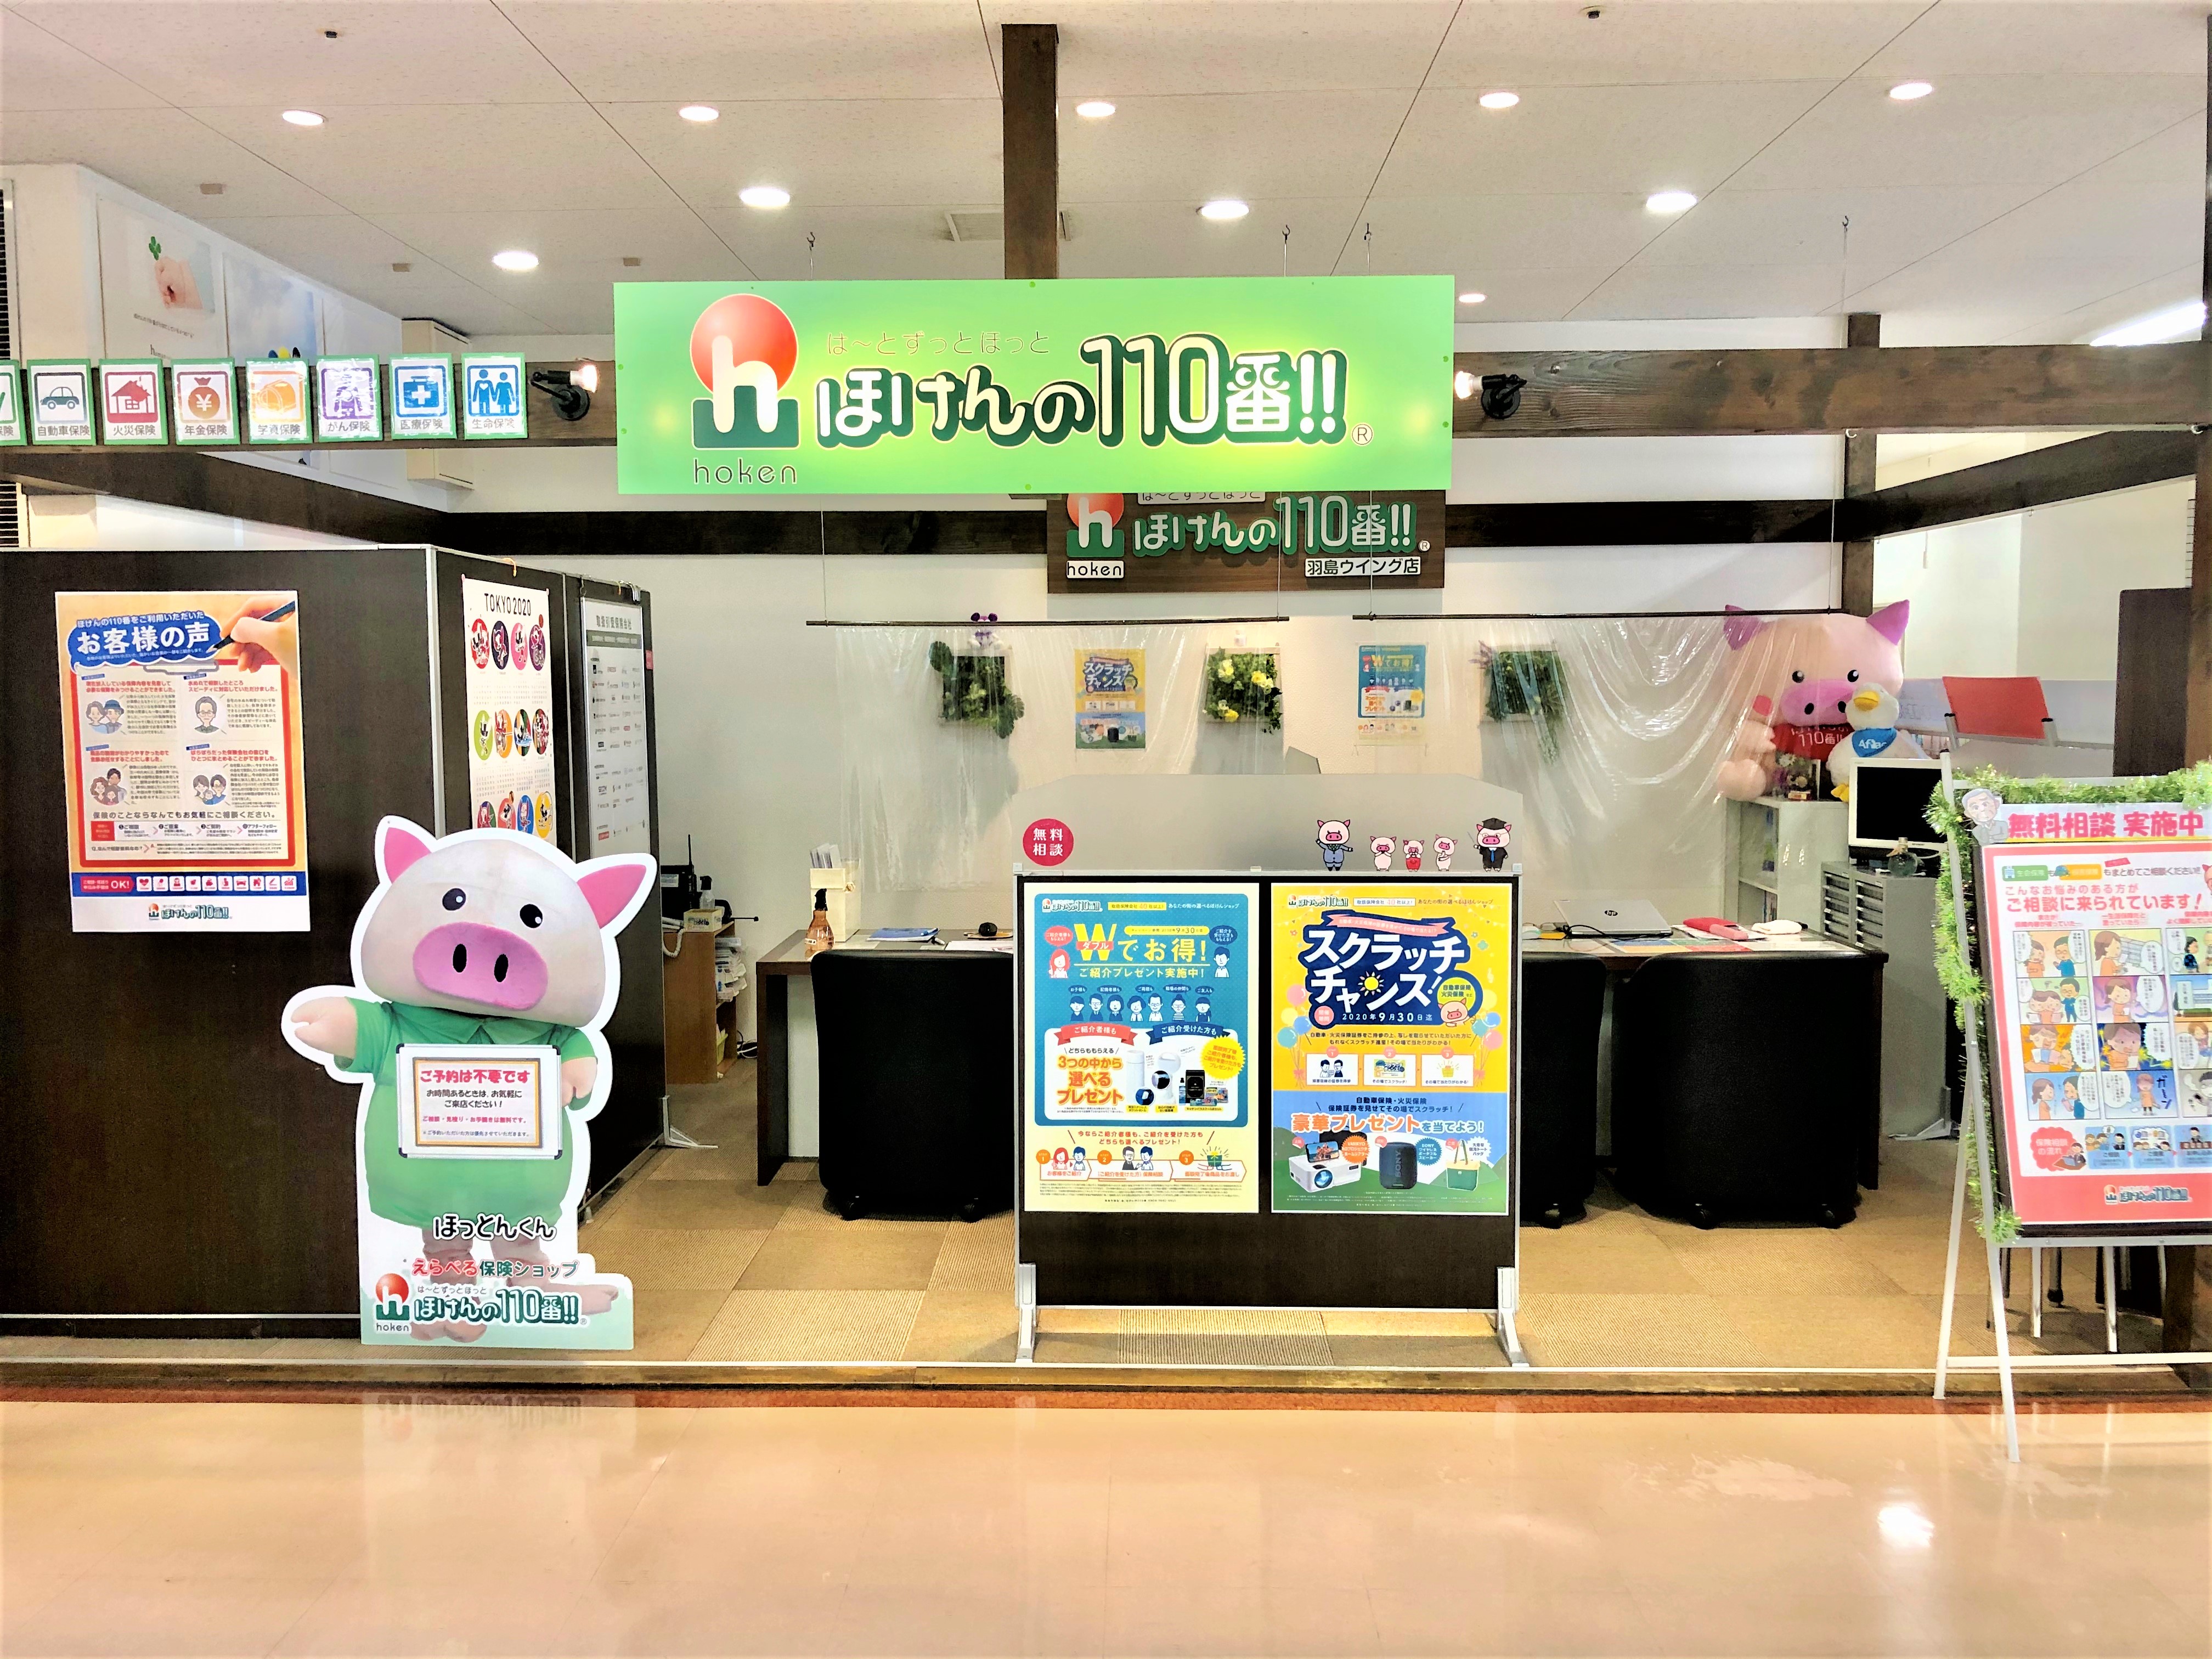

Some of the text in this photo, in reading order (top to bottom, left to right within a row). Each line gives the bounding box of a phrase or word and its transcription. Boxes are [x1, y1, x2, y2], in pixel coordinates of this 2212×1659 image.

[816, 332, 1348, 448] ほけんの110番!!
[37, 425, 89, 436] 自動車保険
[113, 425, 155, 436] 火災保険
[184, 425, 227, 436] 年金保険
[258, 424, 301, 435] 学資保険
[328, 421, 370, 432] がん保険
[400, 419, 443, 430] 医療保険
[472, 419, 515, 429] 生命保険
[695, 458, 798, 484] hoken
[1133, 495, 1417, 556] ほけんの110番!!
[1067, 562, 1122, 577] hoken
[1307, 558, 1419, 575] 羽島ウイング店
[484, 593, 531, 616] TOKYO 2020
[77, 612, 204, 628] ほけんの110番をご利用いただいた
[77, 622, 210, 654] お客様の声
[1085, 663, 1132, 675] スクラッチ
[93, 811, 275, 819] 保険のことならなんでもお気軽にご相談ください。
[2008, 811, 2204, 838] 無料相談 実施中
[1033, 828, 1063, 841] 無料
[1032, 843, 1063, 856] 相談
[2005, 884, 2138, 895] こんなお悩みのある方が
[2007, 894, 2202, 912] ご相談に来られています!
[1304, 929, 1465, 974] スクラッチ
[1080, 967, 1204, 978] ご紹介プレゼント実施中!
[1311, 965, 1442, 1013] チャンス!
[1342, 1013, 1432, 1022] 2020年9月30日迄
[1075, 1026, 1116, 1034] ご紹介者様も
[1161, 1025, 1216, 1035] ご紹介受けた方も
[1058, 1056, 1122, 1069] 3つの中から
[420, 1070, 530, 1084] ご予約は不要です
[1069, 1071, 1111, 1087] 選べる
[426, 1090, 522, 1098] お時間あるときは、お気軽に
[1057, 1089, 1123, 1104] プレゼント
[444, 1100, 503, 1108] ご来店ください!
[1293, 1114, 1484, 1133] 豪華プレゼントを当てよう!
[433, 1212, 557, 1240] ほっとんくん
[412, 1259, 580, 1278] えらべる保険ショップ
[414, 1289, 579, 1324] ほけんの110番!!
[376, 1323, 409, 1331] hoken
